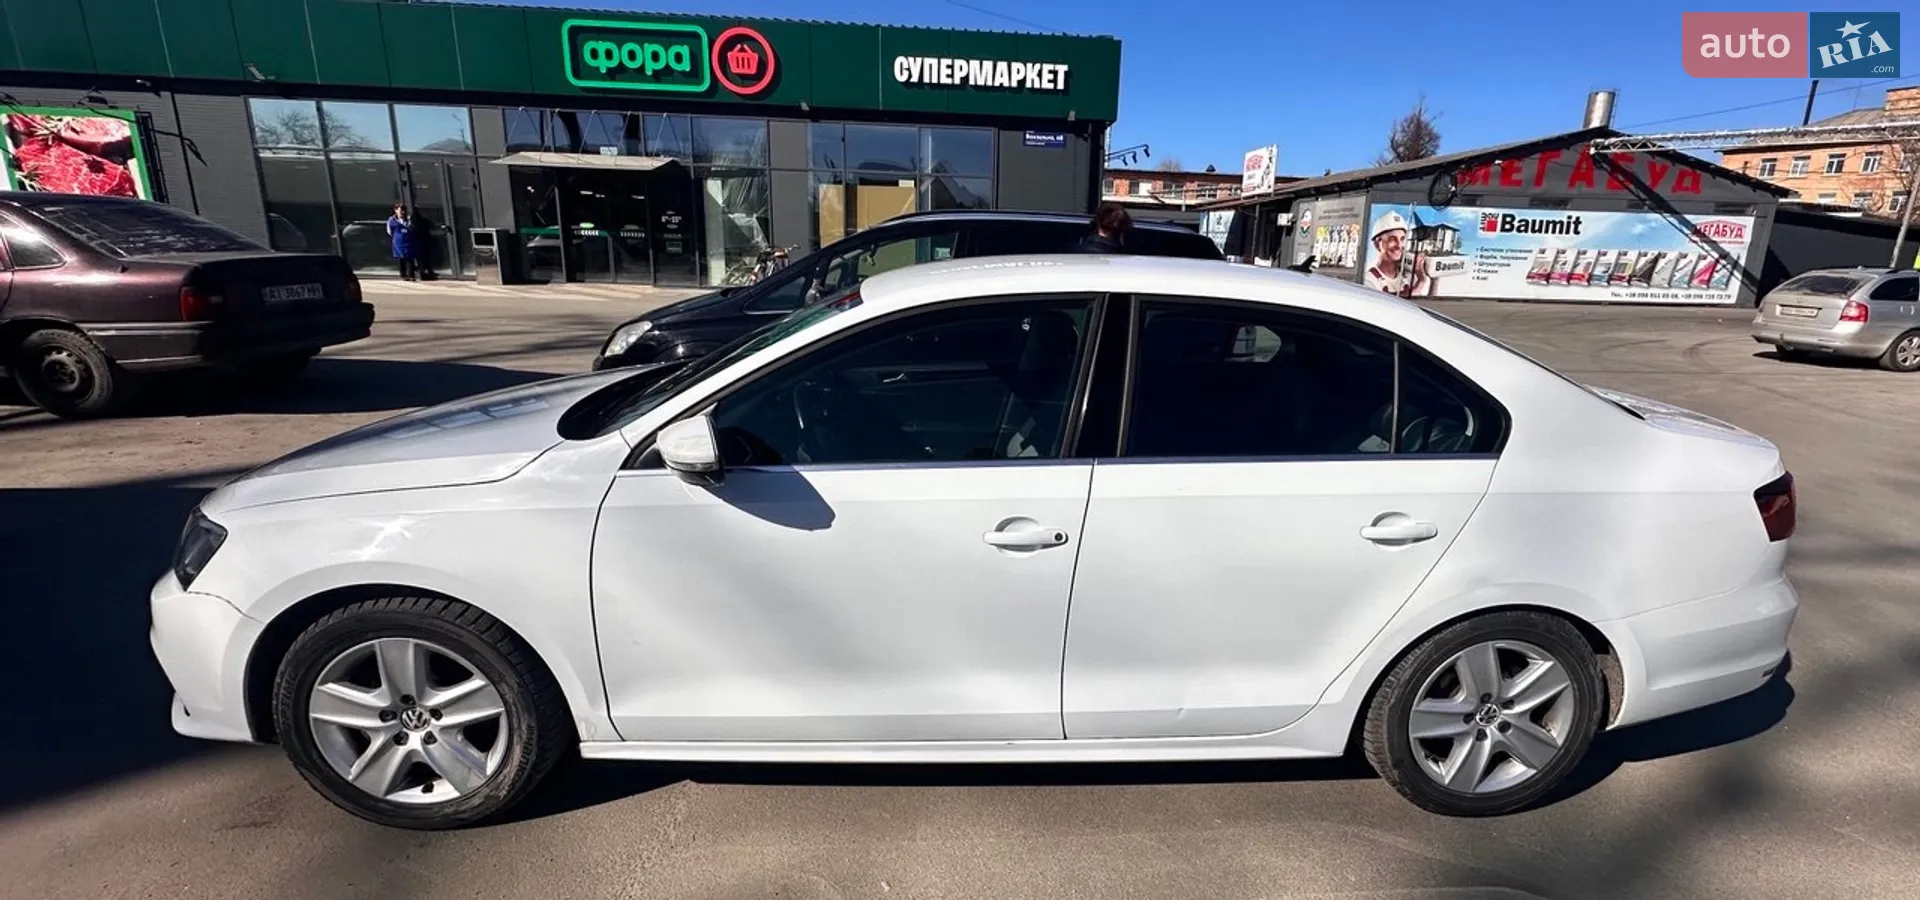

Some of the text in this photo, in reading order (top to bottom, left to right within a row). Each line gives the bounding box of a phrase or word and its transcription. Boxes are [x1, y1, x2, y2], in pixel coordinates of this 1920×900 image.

[583, 40, 691, 75] фора
[893, 55, 1069, 90] СУПЕРМАРКЕТ
[1500, 213, 1582, 235] Baumit
[1435, 261, 1465, 272] Baumit
